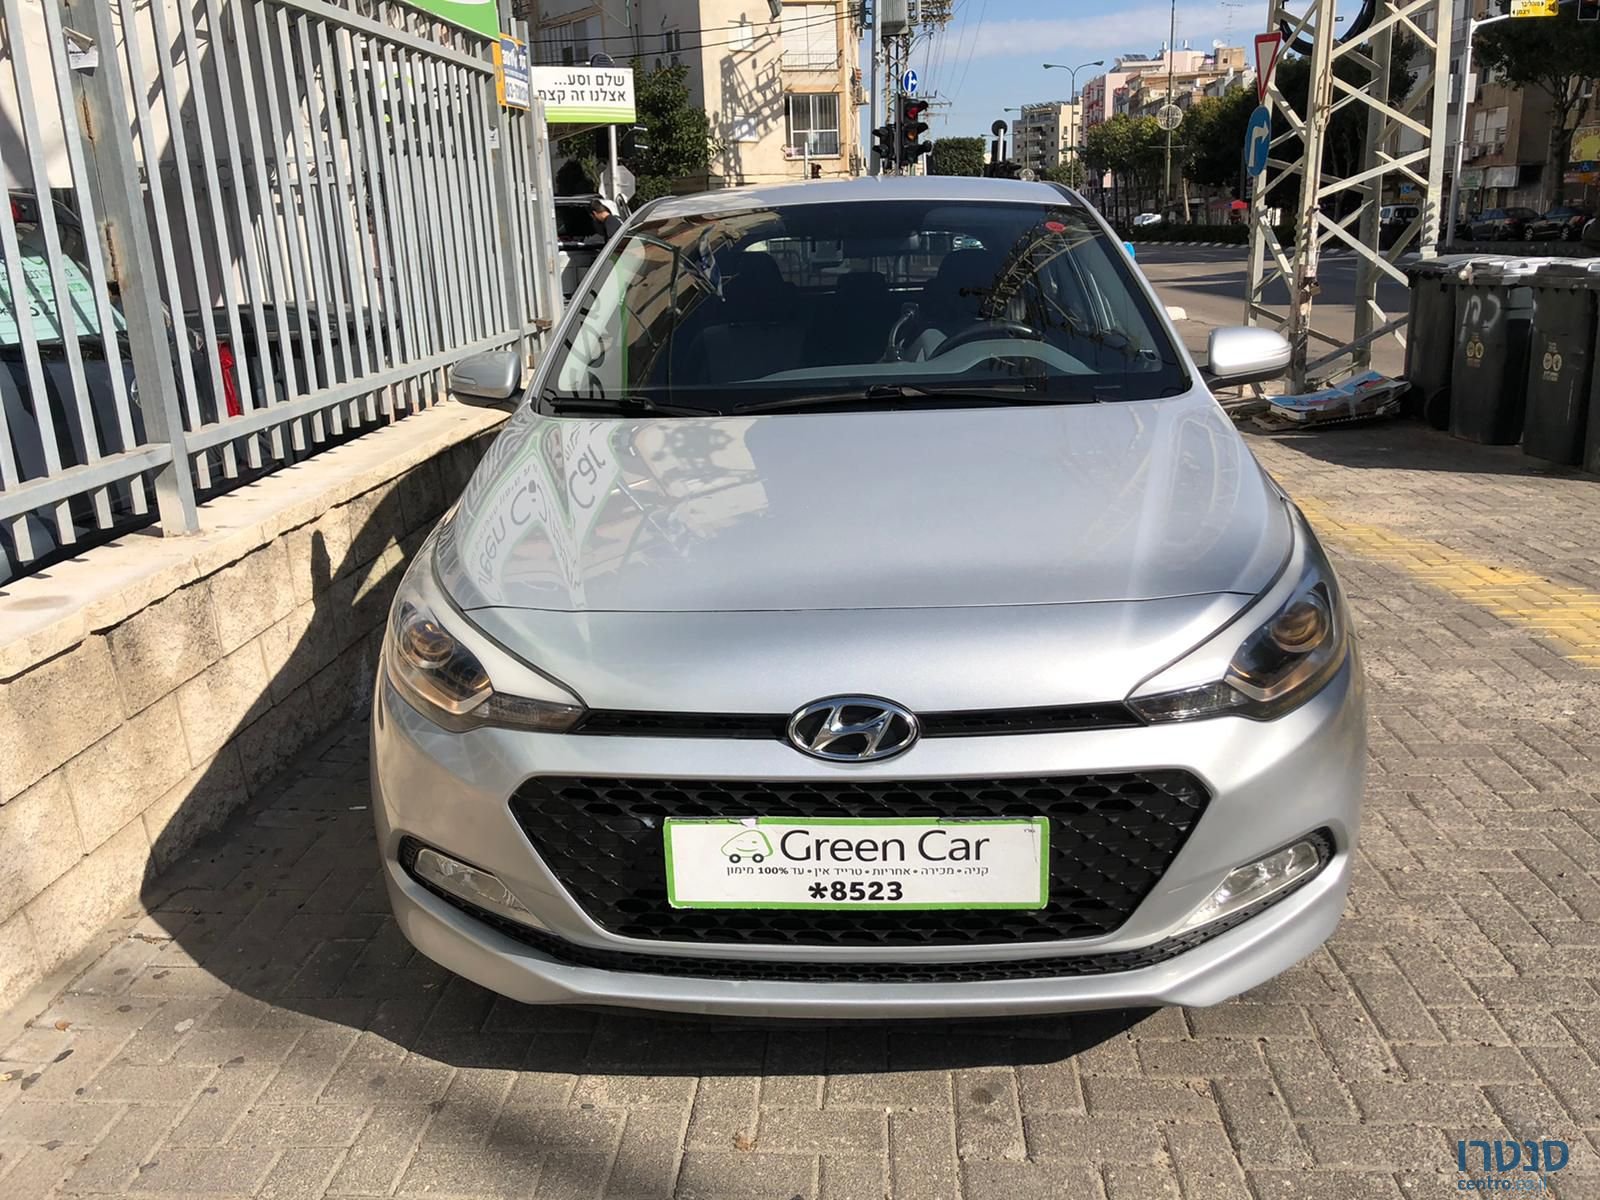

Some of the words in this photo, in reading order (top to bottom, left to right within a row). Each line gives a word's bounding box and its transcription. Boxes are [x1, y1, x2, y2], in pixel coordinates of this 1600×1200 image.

[554, 74, 591, 86] וסע...
[595, 72, 625, 87] שלם
[571, 91, 585, 101] זה
[590, 88, 627, 102] אצלנו
[780, 829, 905, 862] Green
[918, 829, 990, 862] Car
[727, 866, 754, 876] מימון
[758, 866, 789, 875] 100%
[791, 867, 805, 875] עד
[814, 867, 830, 877] אין
[834, 867, 863, 876] טרייד
[872, 867, 911, 876] אחריות
[920, 866, 955, 876] מכירה
[964, 867, 989, 877] קניה
